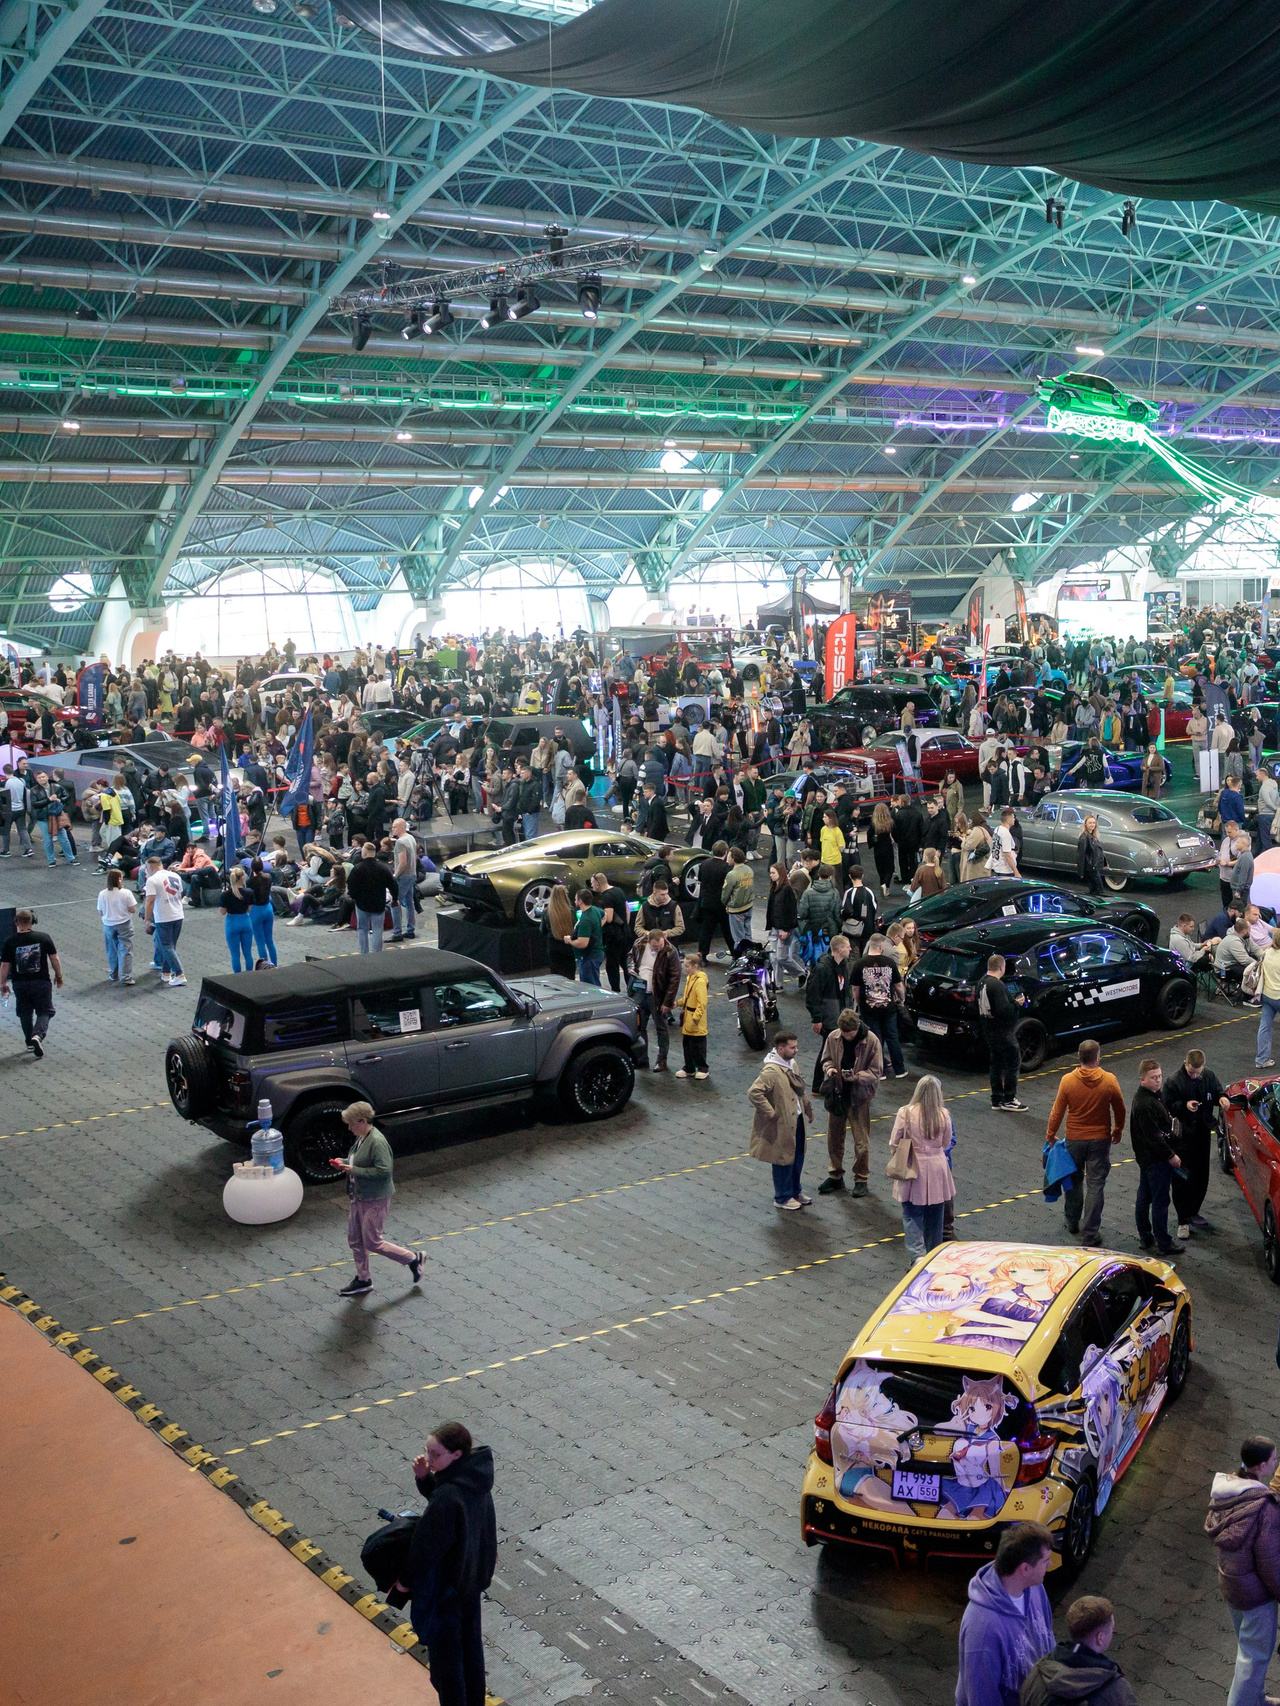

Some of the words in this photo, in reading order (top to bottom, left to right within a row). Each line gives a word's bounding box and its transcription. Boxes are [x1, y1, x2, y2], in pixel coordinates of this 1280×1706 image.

[1083, 393, 1111, 402] BETERA
[1105, 984, 1139, 997] WESTMOTORS
[912, 1472, 934, 1485] 993
[897, 1485, 914, 1497] AX
[919, 1486, 938, 1497] 550
[861, 1520, 910, 1535] NEKOPARA
[928, 1531, 960, 1540] PARADISE
